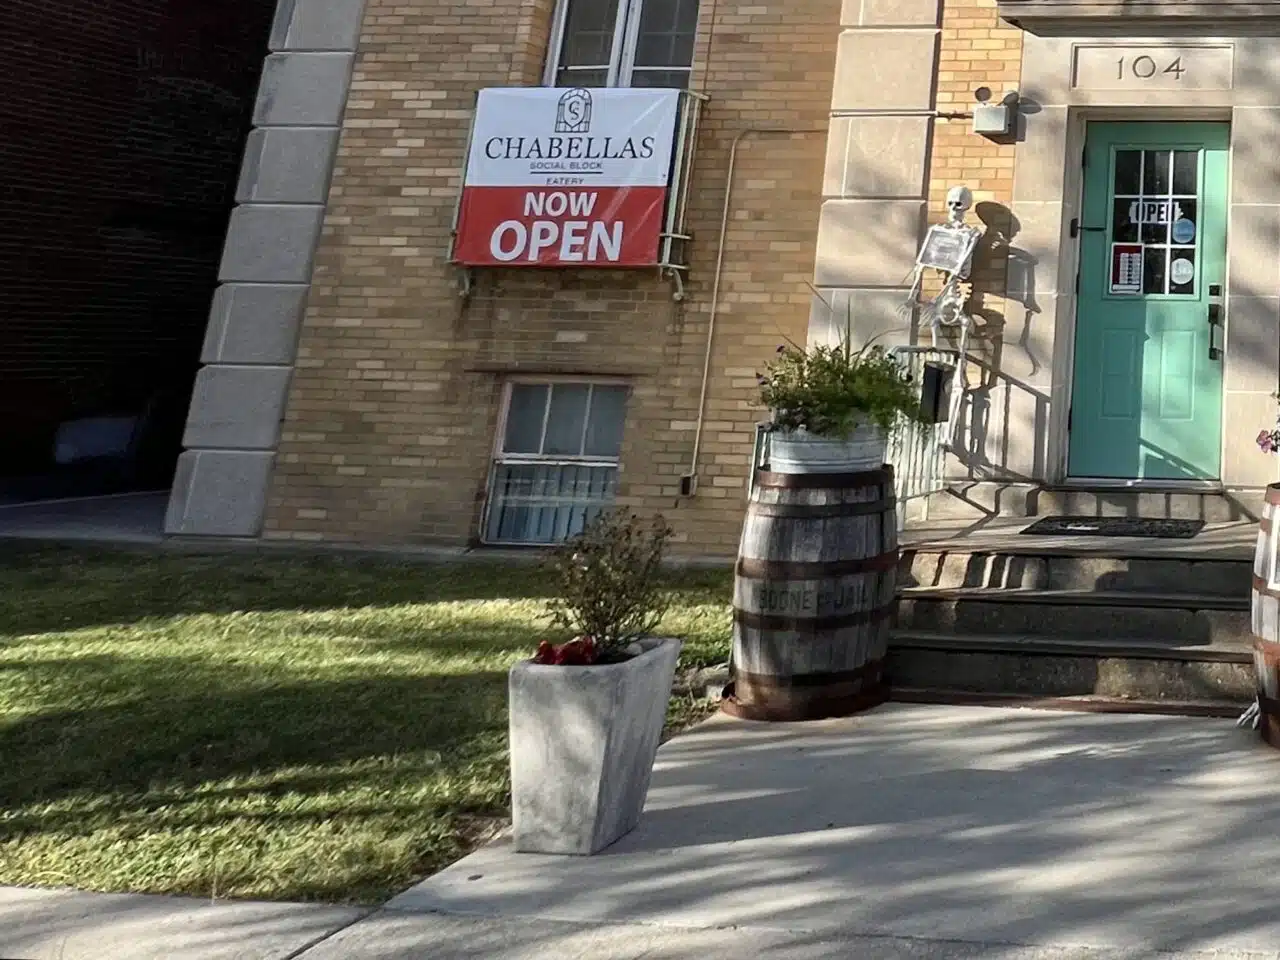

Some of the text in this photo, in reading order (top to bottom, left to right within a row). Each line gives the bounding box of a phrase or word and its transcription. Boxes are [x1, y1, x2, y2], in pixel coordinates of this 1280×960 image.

[1116, 55, 1186, 80] 104
[484, 136, 655, 159] CHABELLAS
[529, 161, 602, 170] SOCIAL BLOCK
[546, 177, 584, 185] EATERY
[523, 191, 597, 217] NOW
[1135, 203, 1176, 222] OPEN
[489, 220, 623, 262] OPEN
